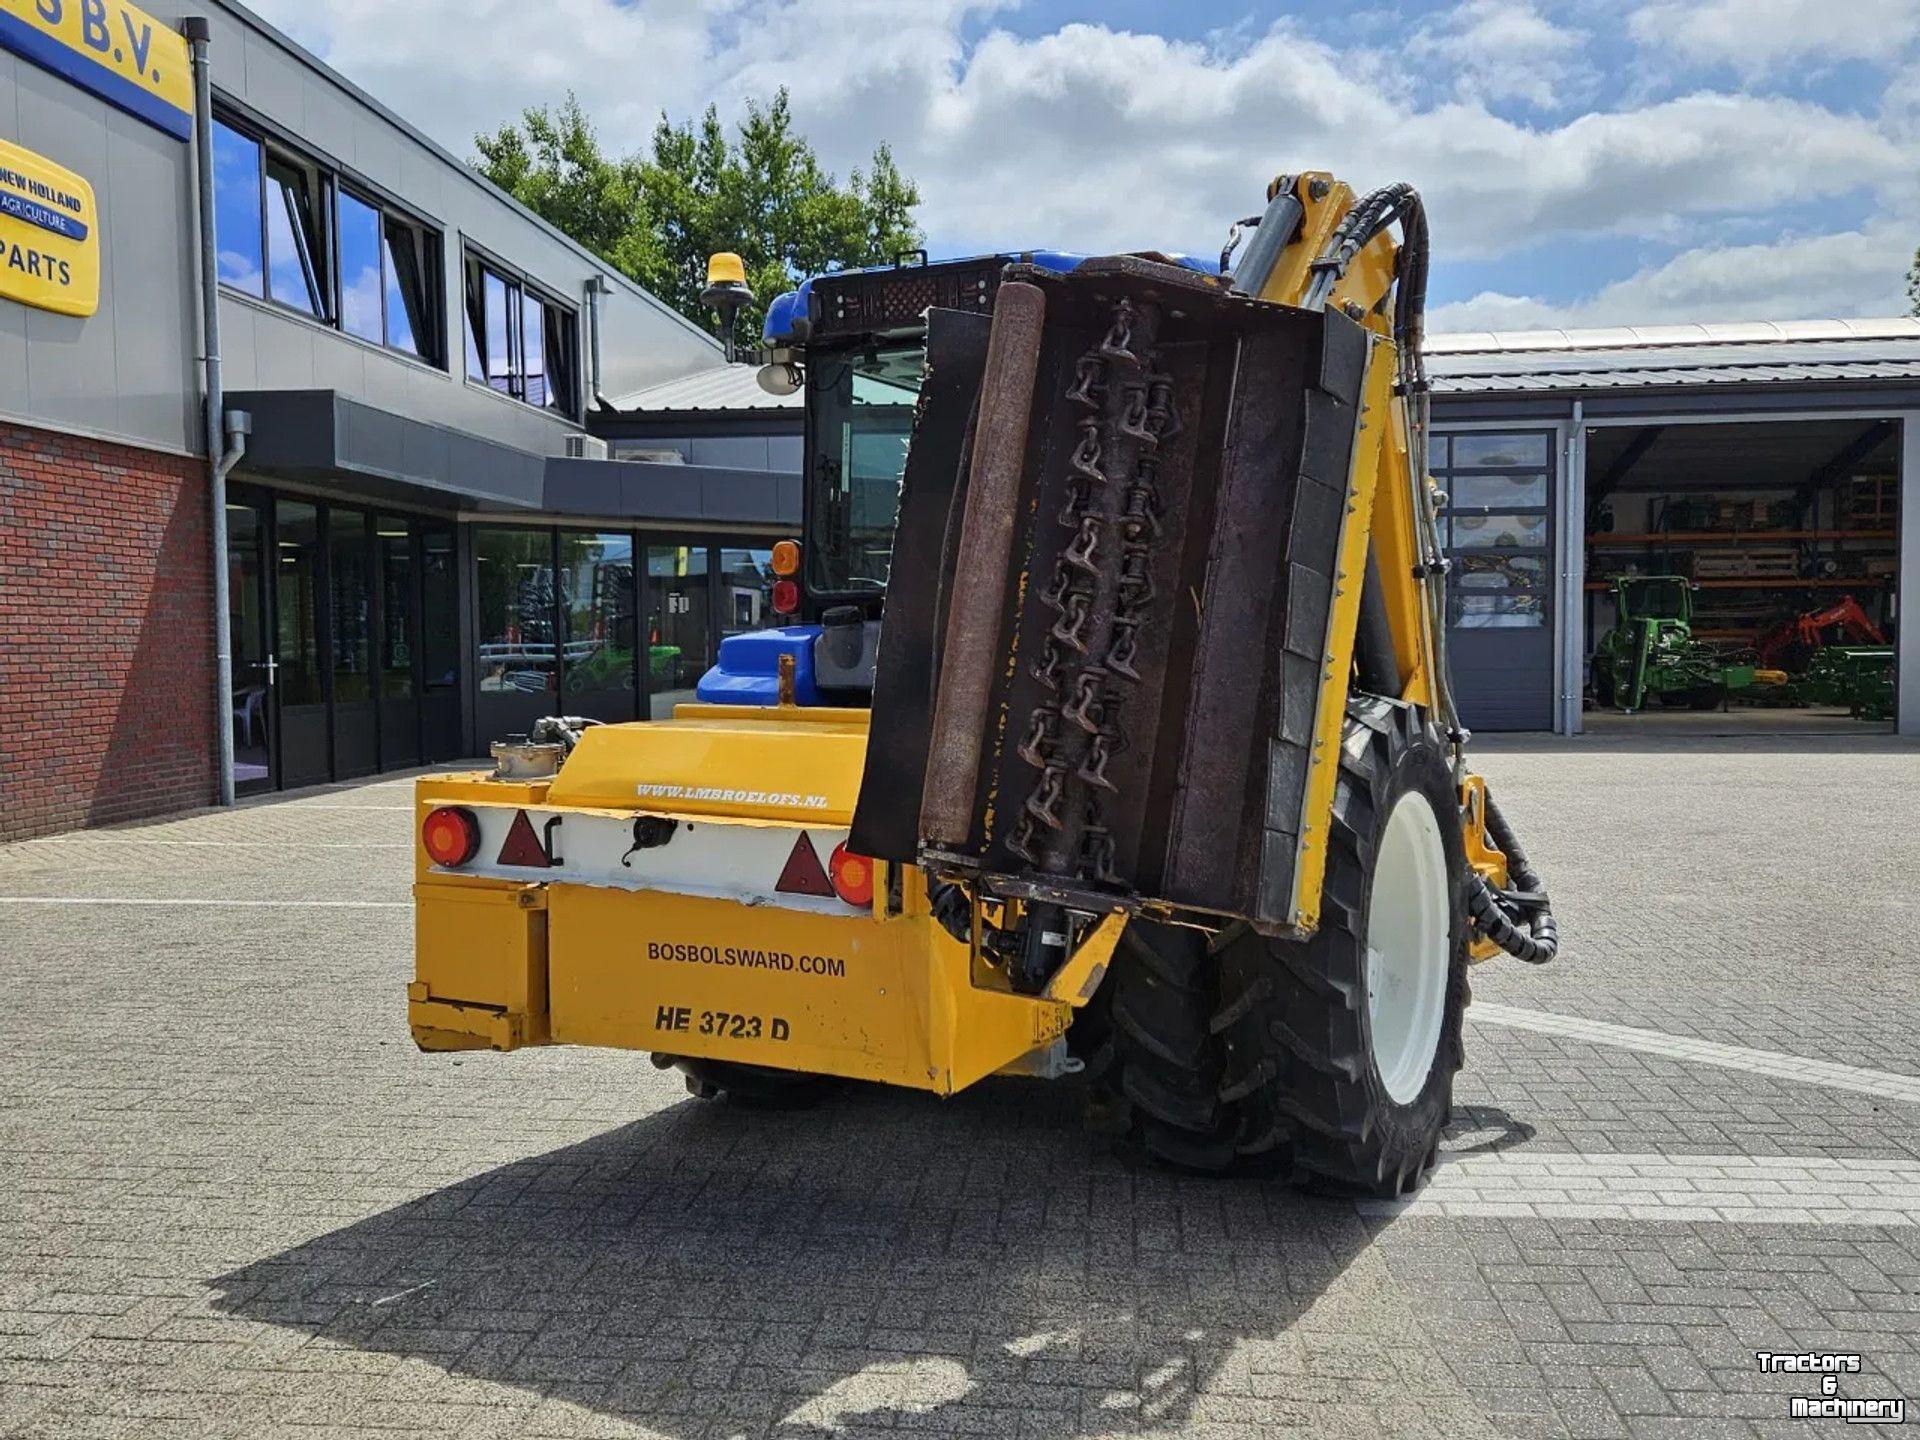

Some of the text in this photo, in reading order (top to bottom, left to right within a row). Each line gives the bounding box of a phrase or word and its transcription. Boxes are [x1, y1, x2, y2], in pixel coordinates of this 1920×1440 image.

[82, 0, 161, 84] B.V.
[0, 167, 81, 213] NEW HOLLAND
[1, 195, 67, 230] AGRICULTURE
[636, 784, 828, 809] WWW.LMBROELOFS.NL
[648, 943, 846, 977] BOSBOLSWARD.COM
[655, 1005, 790, 1041] HE 3723 D
